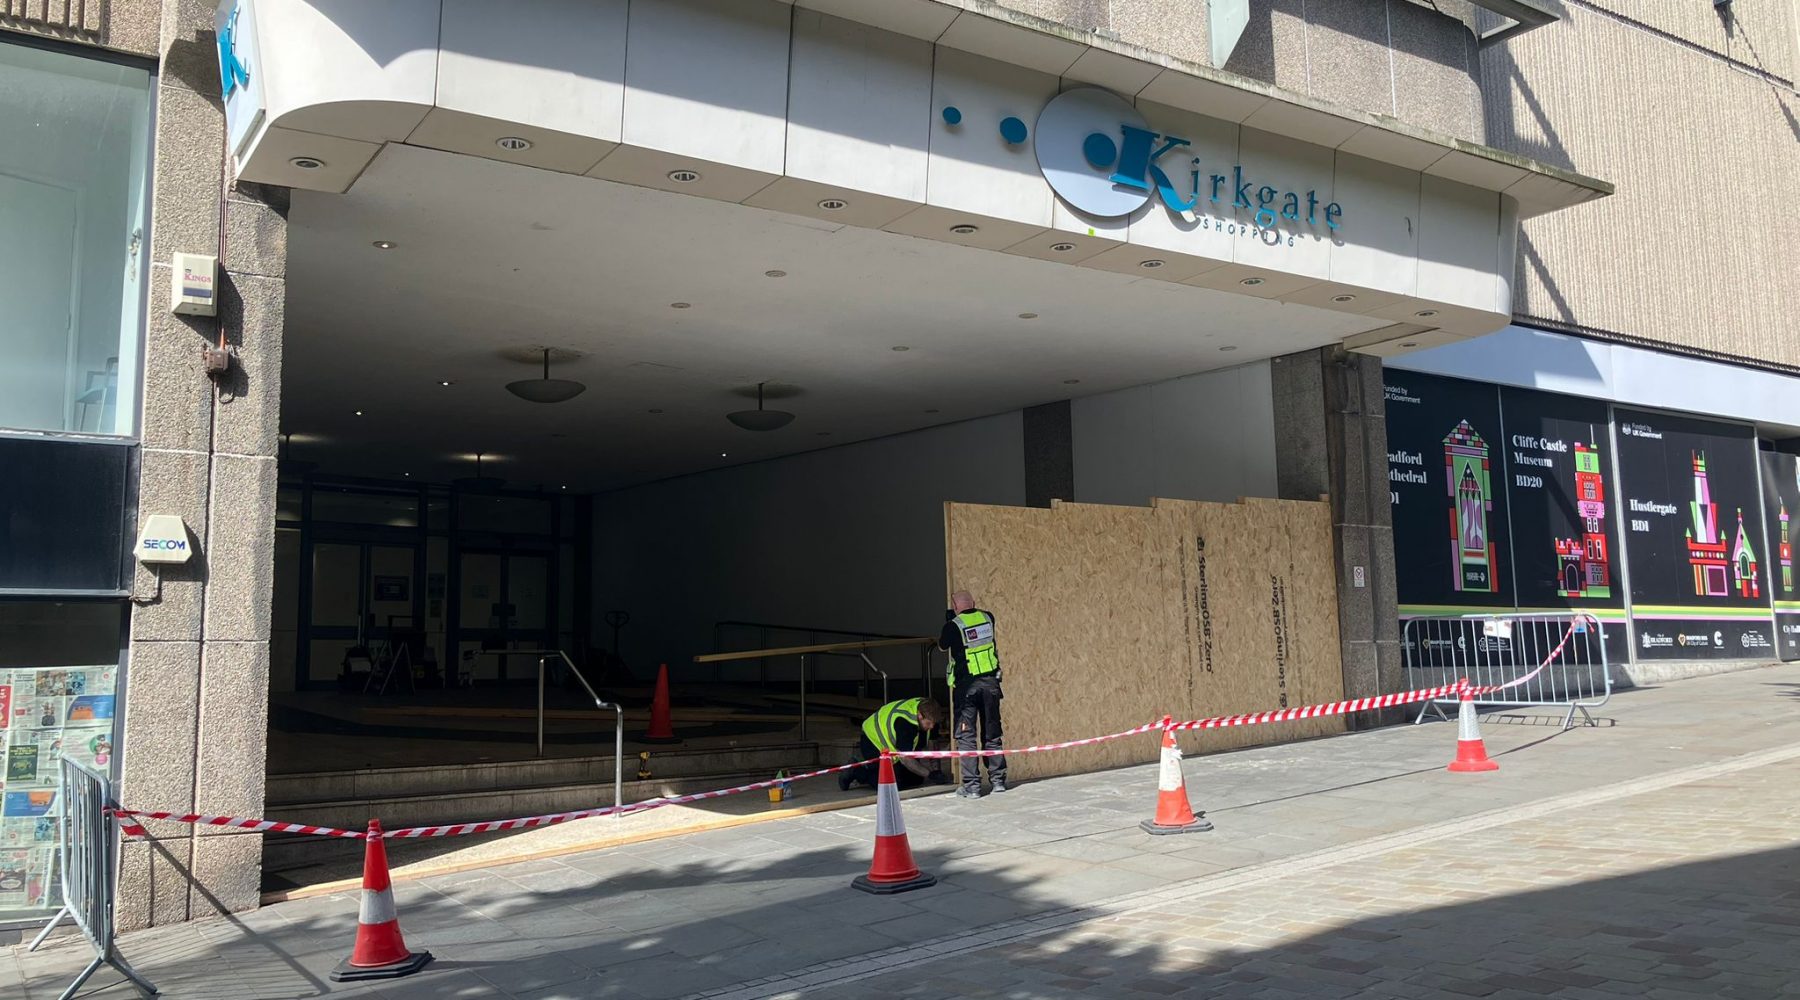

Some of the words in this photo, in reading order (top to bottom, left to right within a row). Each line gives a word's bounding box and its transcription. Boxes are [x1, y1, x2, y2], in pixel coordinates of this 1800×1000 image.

[1108, 125, 1342, 230] Kirkgate
[1202, 218, 1295, 248] SHOPPING
[1512, 434, 1539, 449] Cliffe
[1540, 437, 1568, 453] Castle
[1387, 450, 1423, 465] adford
[1514, 451, 1553, 468] Museum
[1388, 468, 1427, 484] thedral
[1516, 474, 1543, 488] BD20
[1629, 498, 1678, 516] Hustlergate
[1631, 519, 1650, 532] BD1
[143, 539, 186, 550] SECOM
